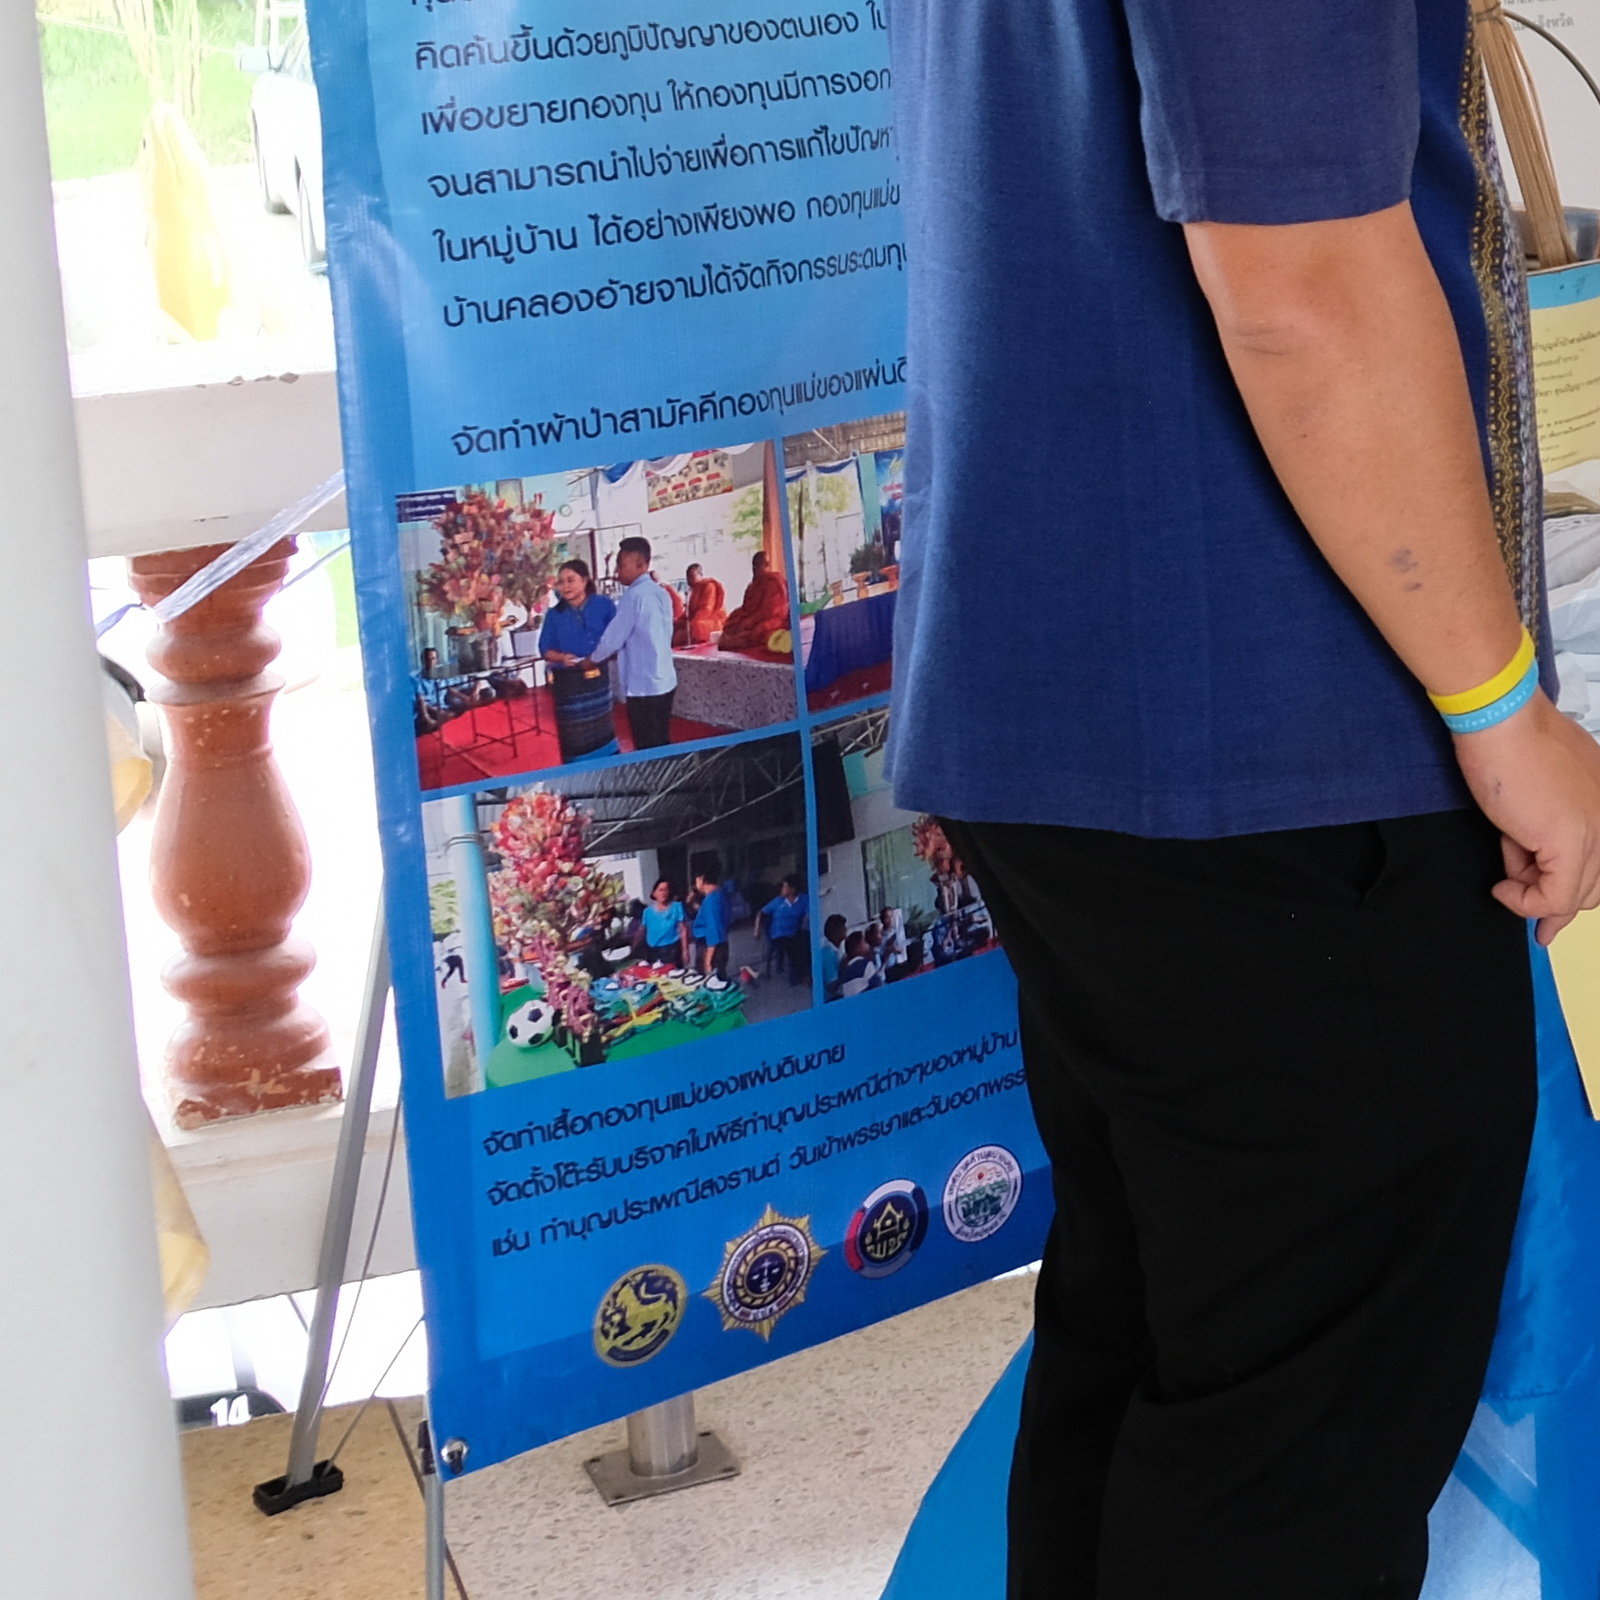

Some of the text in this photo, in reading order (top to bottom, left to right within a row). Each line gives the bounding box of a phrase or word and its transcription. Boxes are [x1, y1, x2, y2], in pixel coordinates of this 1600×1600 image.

[421, 87, 662, 137] เพื่อขยายกองทุน
[427, 124, 894, 199] จนสามารถนำไปจ่ายเพื่อการแก้ไขปัญห
[433, 228, 579, 264] ในหมู่บ้าน
[590, 197, 796, 246] ได้อย่างเพียงพอ
